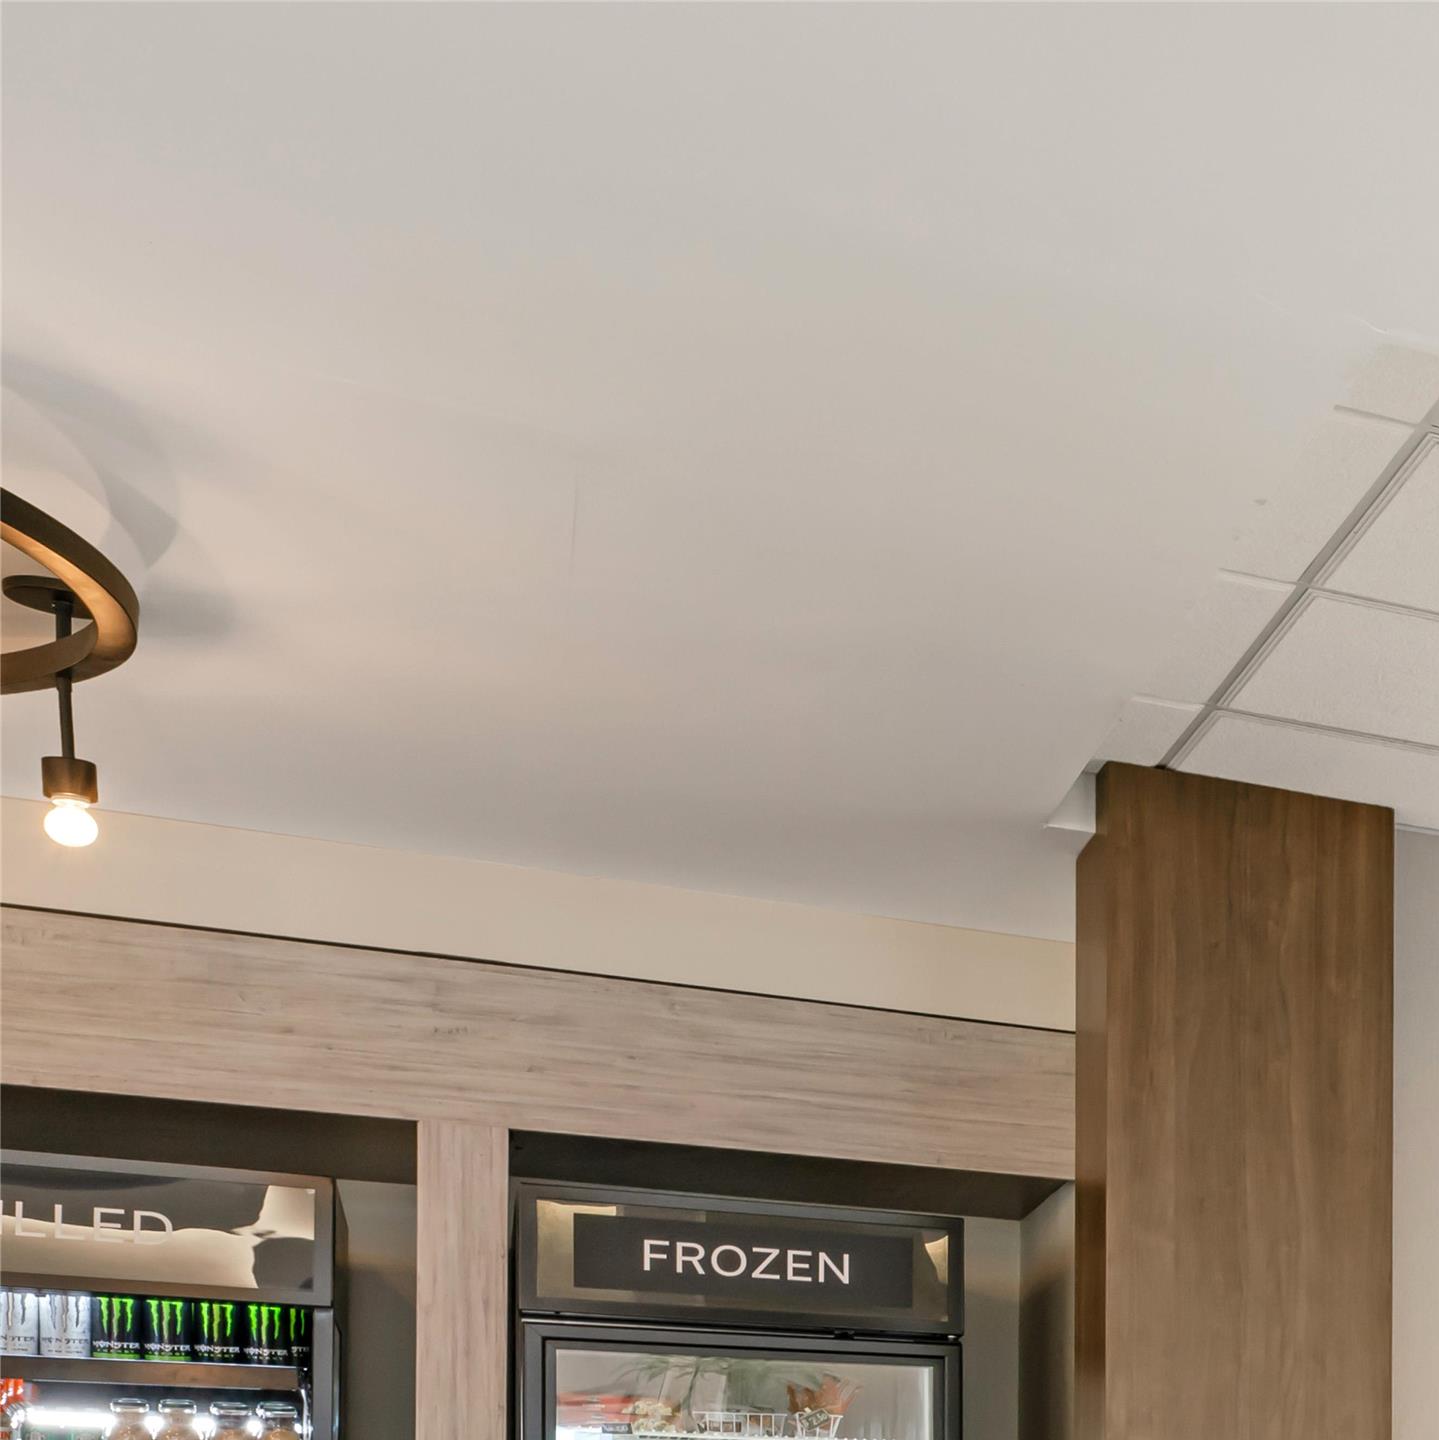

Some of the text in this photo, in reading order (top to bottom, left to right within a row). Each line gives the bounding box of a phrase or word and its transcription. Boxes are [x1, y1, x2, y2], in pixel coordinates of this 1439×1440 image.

[643, 1239, 850, 1285] FROZEN
[92, 1340, 140, 1350] MONSTER
[144, 1342, 191, 1352] MONSTER
[194, 1344, 240, 1353] MONSTER
